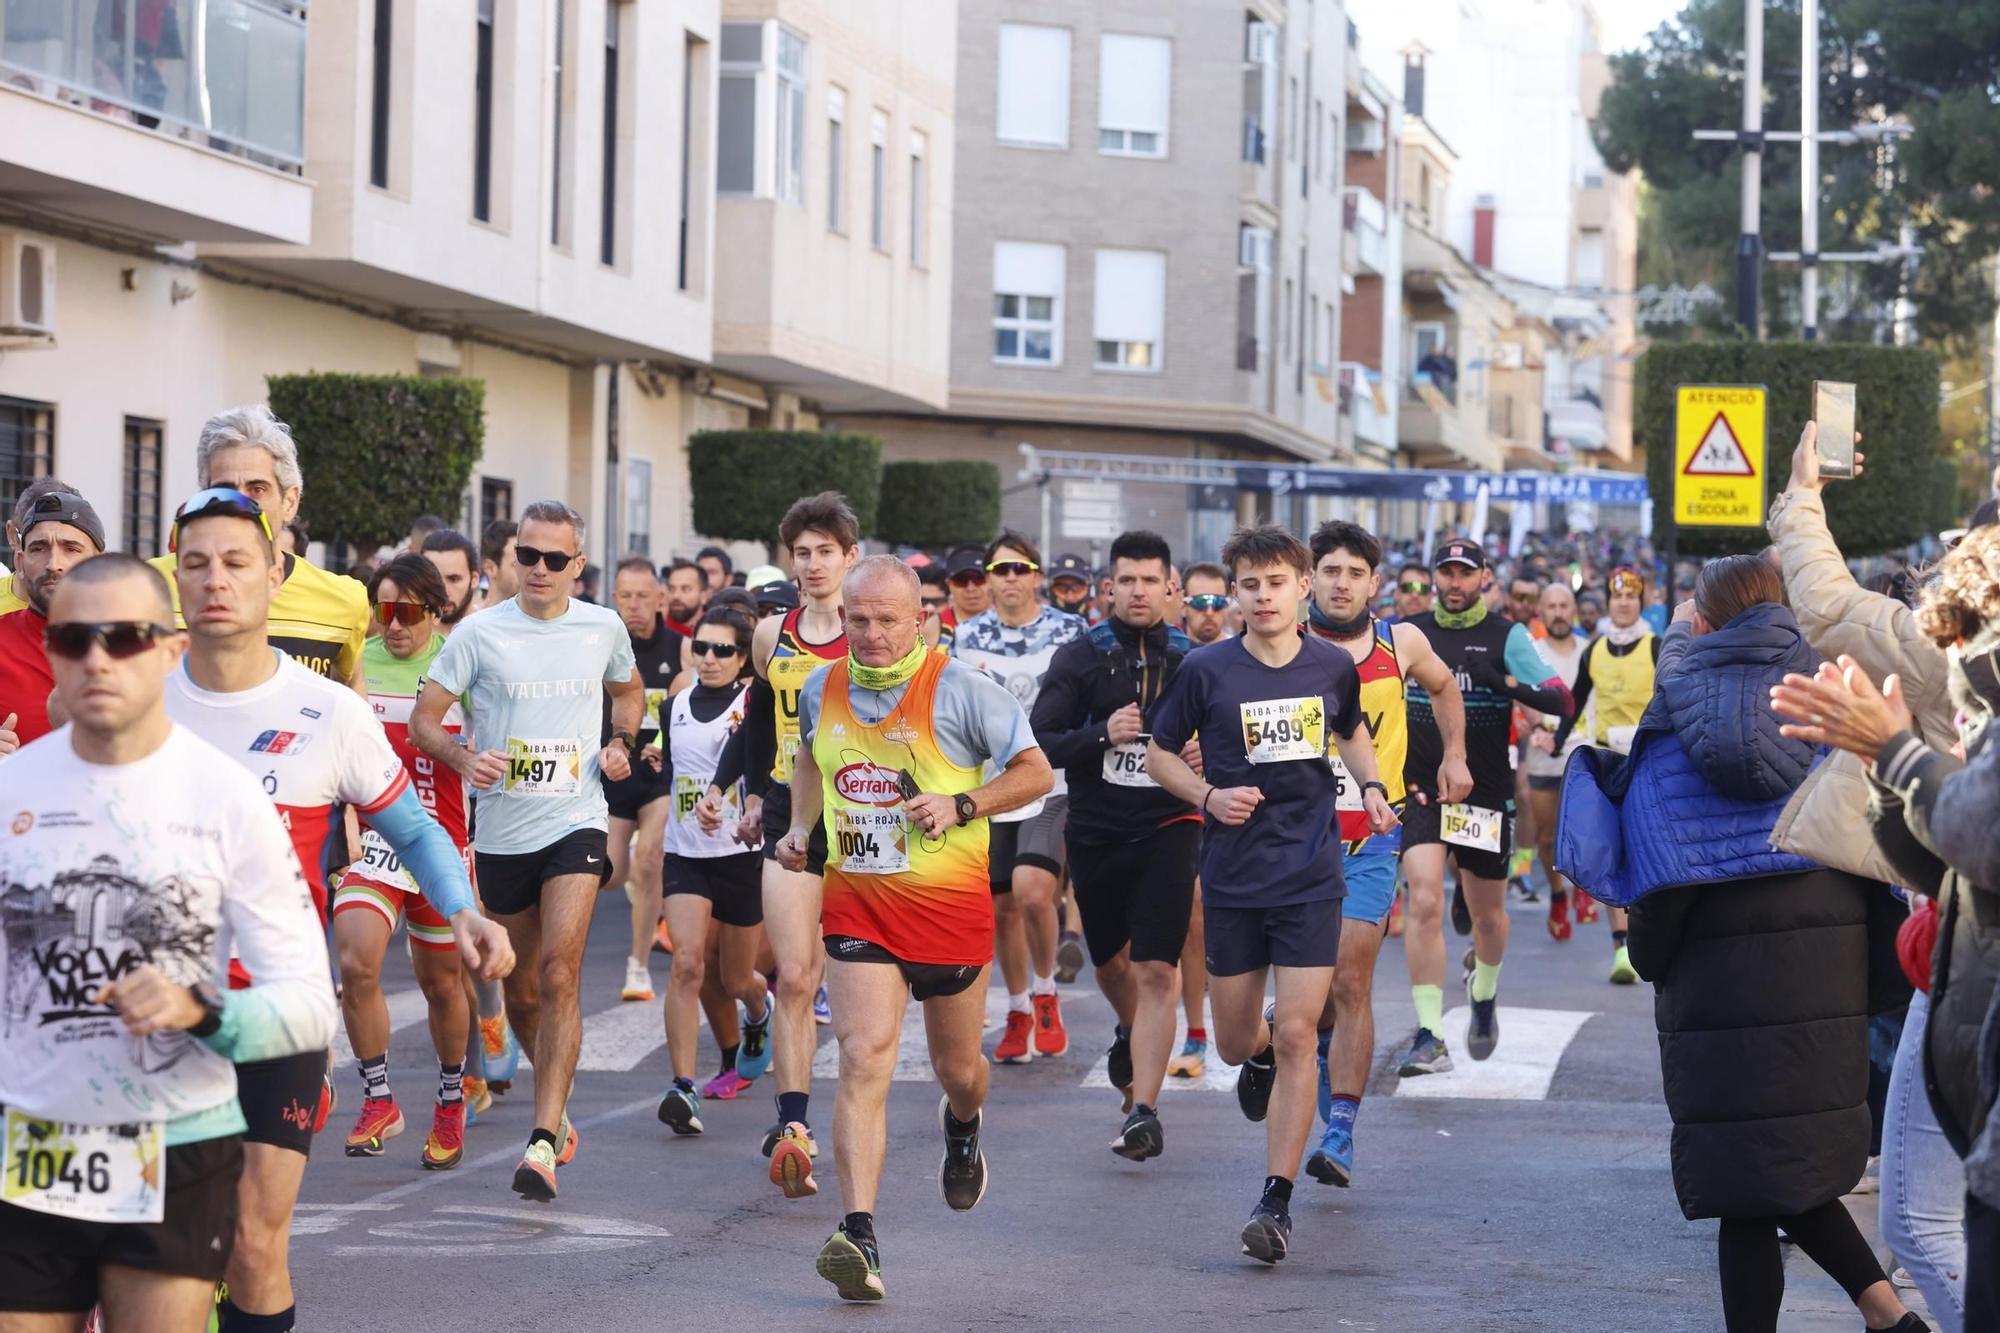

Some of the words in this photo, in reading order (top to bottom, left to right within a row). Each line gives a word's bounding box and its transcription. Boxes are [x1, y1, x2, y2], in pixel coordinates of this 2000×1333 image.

[1687, 390, 1757, 405] ATENCIÓ
[1700, 488, 1736, 500] ZONA
[1686, 503, 1749, 516] ESCOLAR
[505, 679, 595, 699] VALENCIA
[1246, 704, 1304, 717] RIBA-ROJA
[1247, 718, 1304, 746] 5499
[523, 744, 577, 753] RIBA-ROJA
[511, 758, 557, 782] 1497
[846, 815, 901, 825] RIBA-ROJA
[1445, 815, 1480, 838] 1540
[837, 830, 880, 858] 1004
[16, 1149, 110, 1194] 1046
